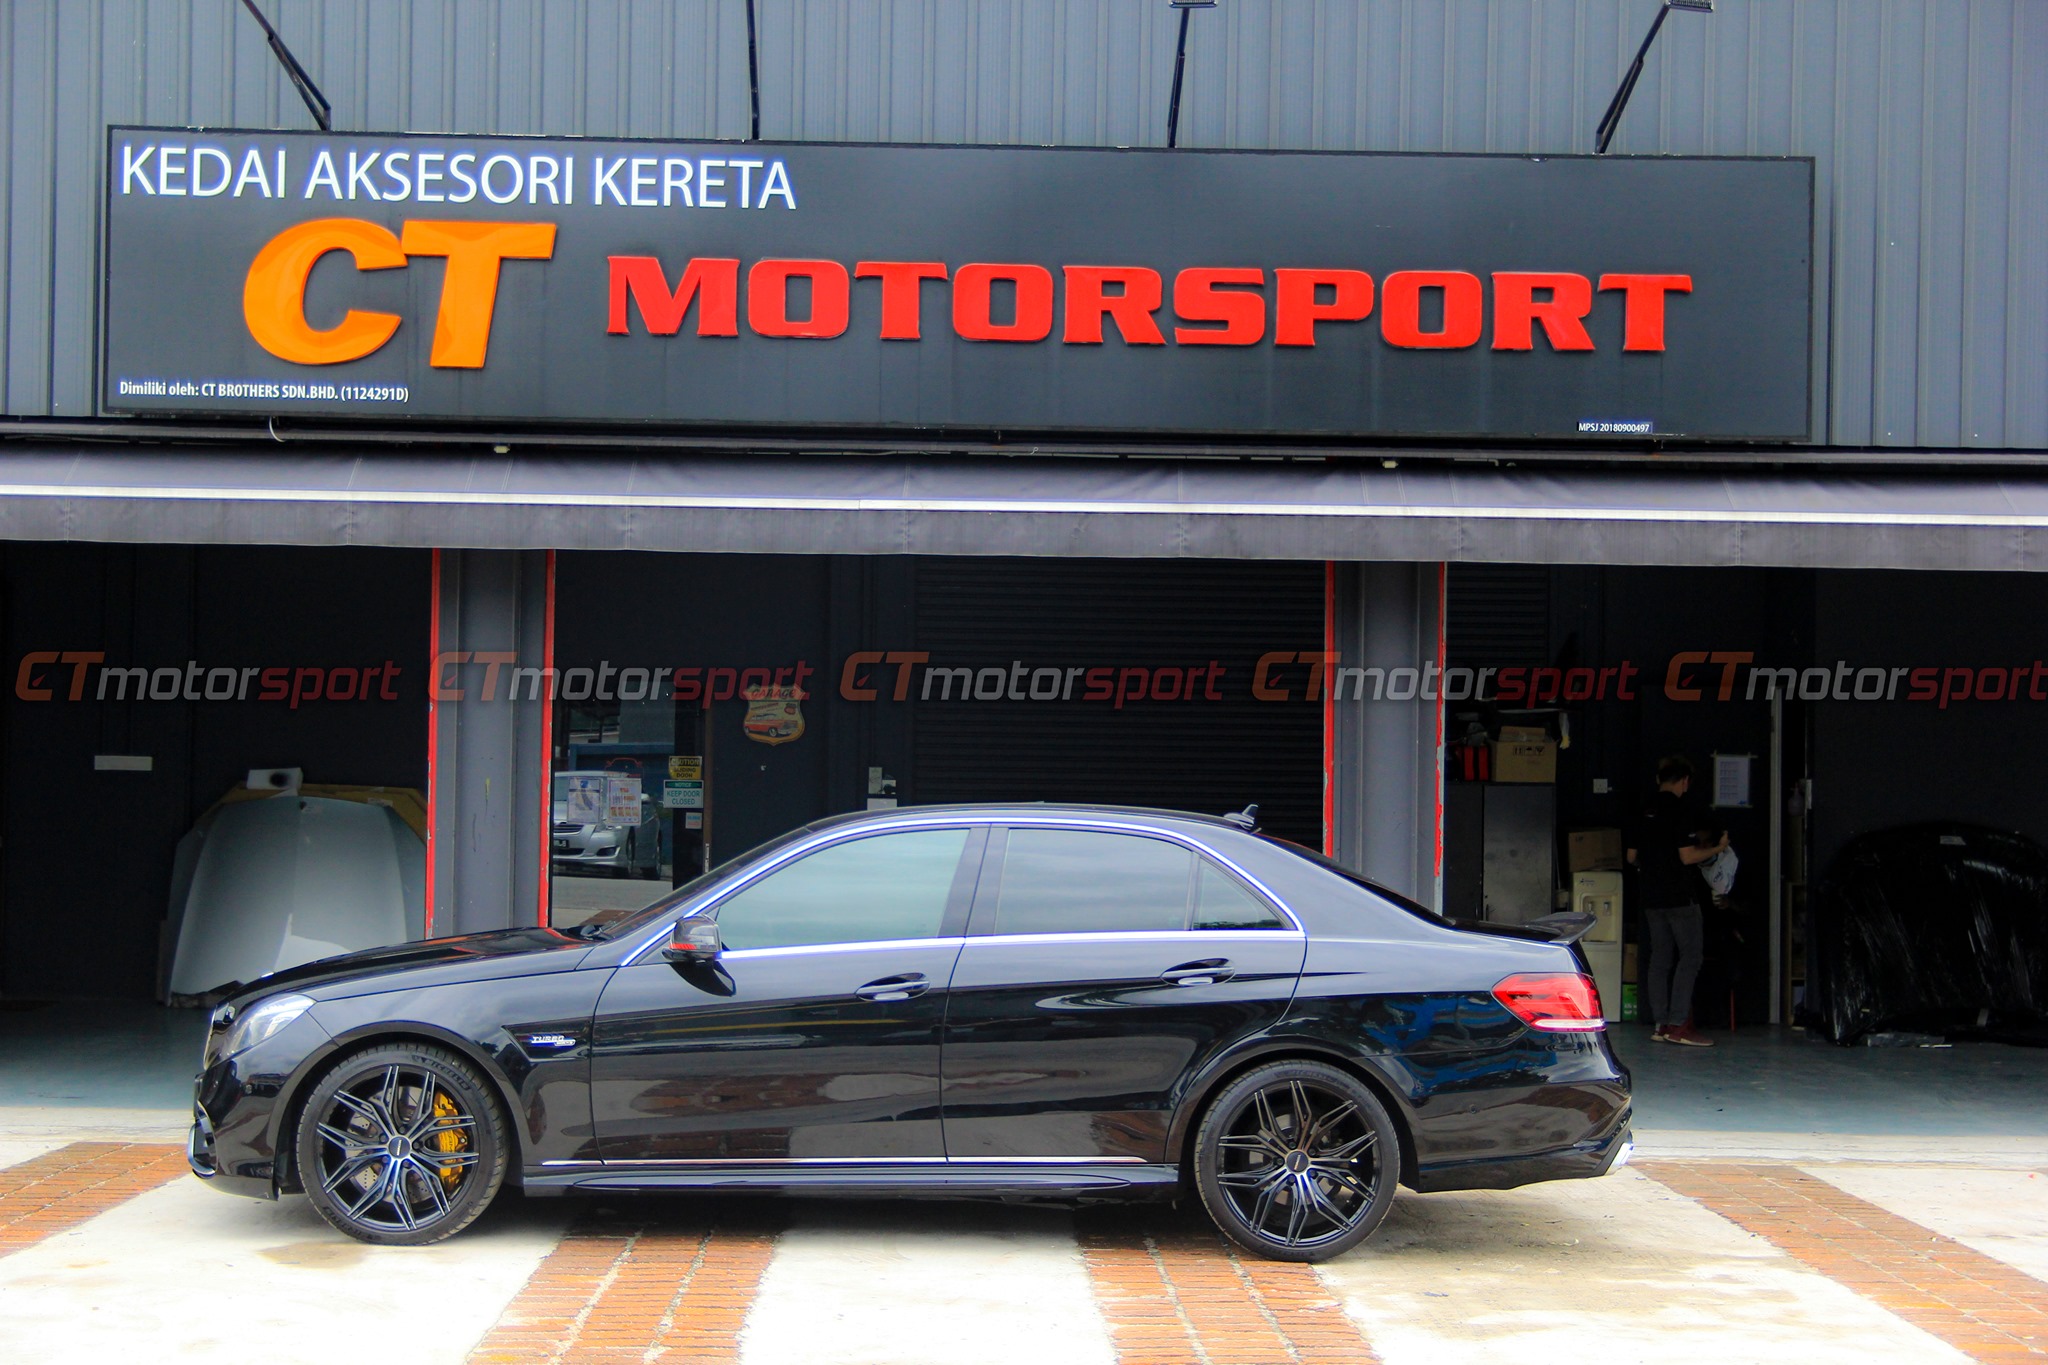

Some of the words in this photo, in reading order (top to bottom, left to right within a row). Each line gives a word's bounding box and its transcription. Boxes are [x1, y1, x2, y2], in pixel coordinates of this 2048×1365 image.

[122, 145, 286, 198] KEDAI
[304, 150, 574, 205] AKSESORI
[594, 156, 797, 210] KERETA
[242, 217, 557, 369] CT
[606, 256, 1694, 352] MOTORSPORT
[119, 380, 167, 396] Dimiliki
[168, 382, 200, 397] oleh:
[201, 382, 217, 397] CT
[218, 383, 280, 398] BROTHERS
[281, 384, 339, 400] SDN.BHD.
[340, 386, 409, 402] (1124291D)
[1578, 422, 1599, 432] MPSJ
[1600, 423, 1650, 433] 20180900497
[751, 688, 797, 700] GARAGE
[671, 758, 699, 766] CAUTION
[666, 790, 682, 798] KEEP
[683, 790, 700, 798] DOOR
